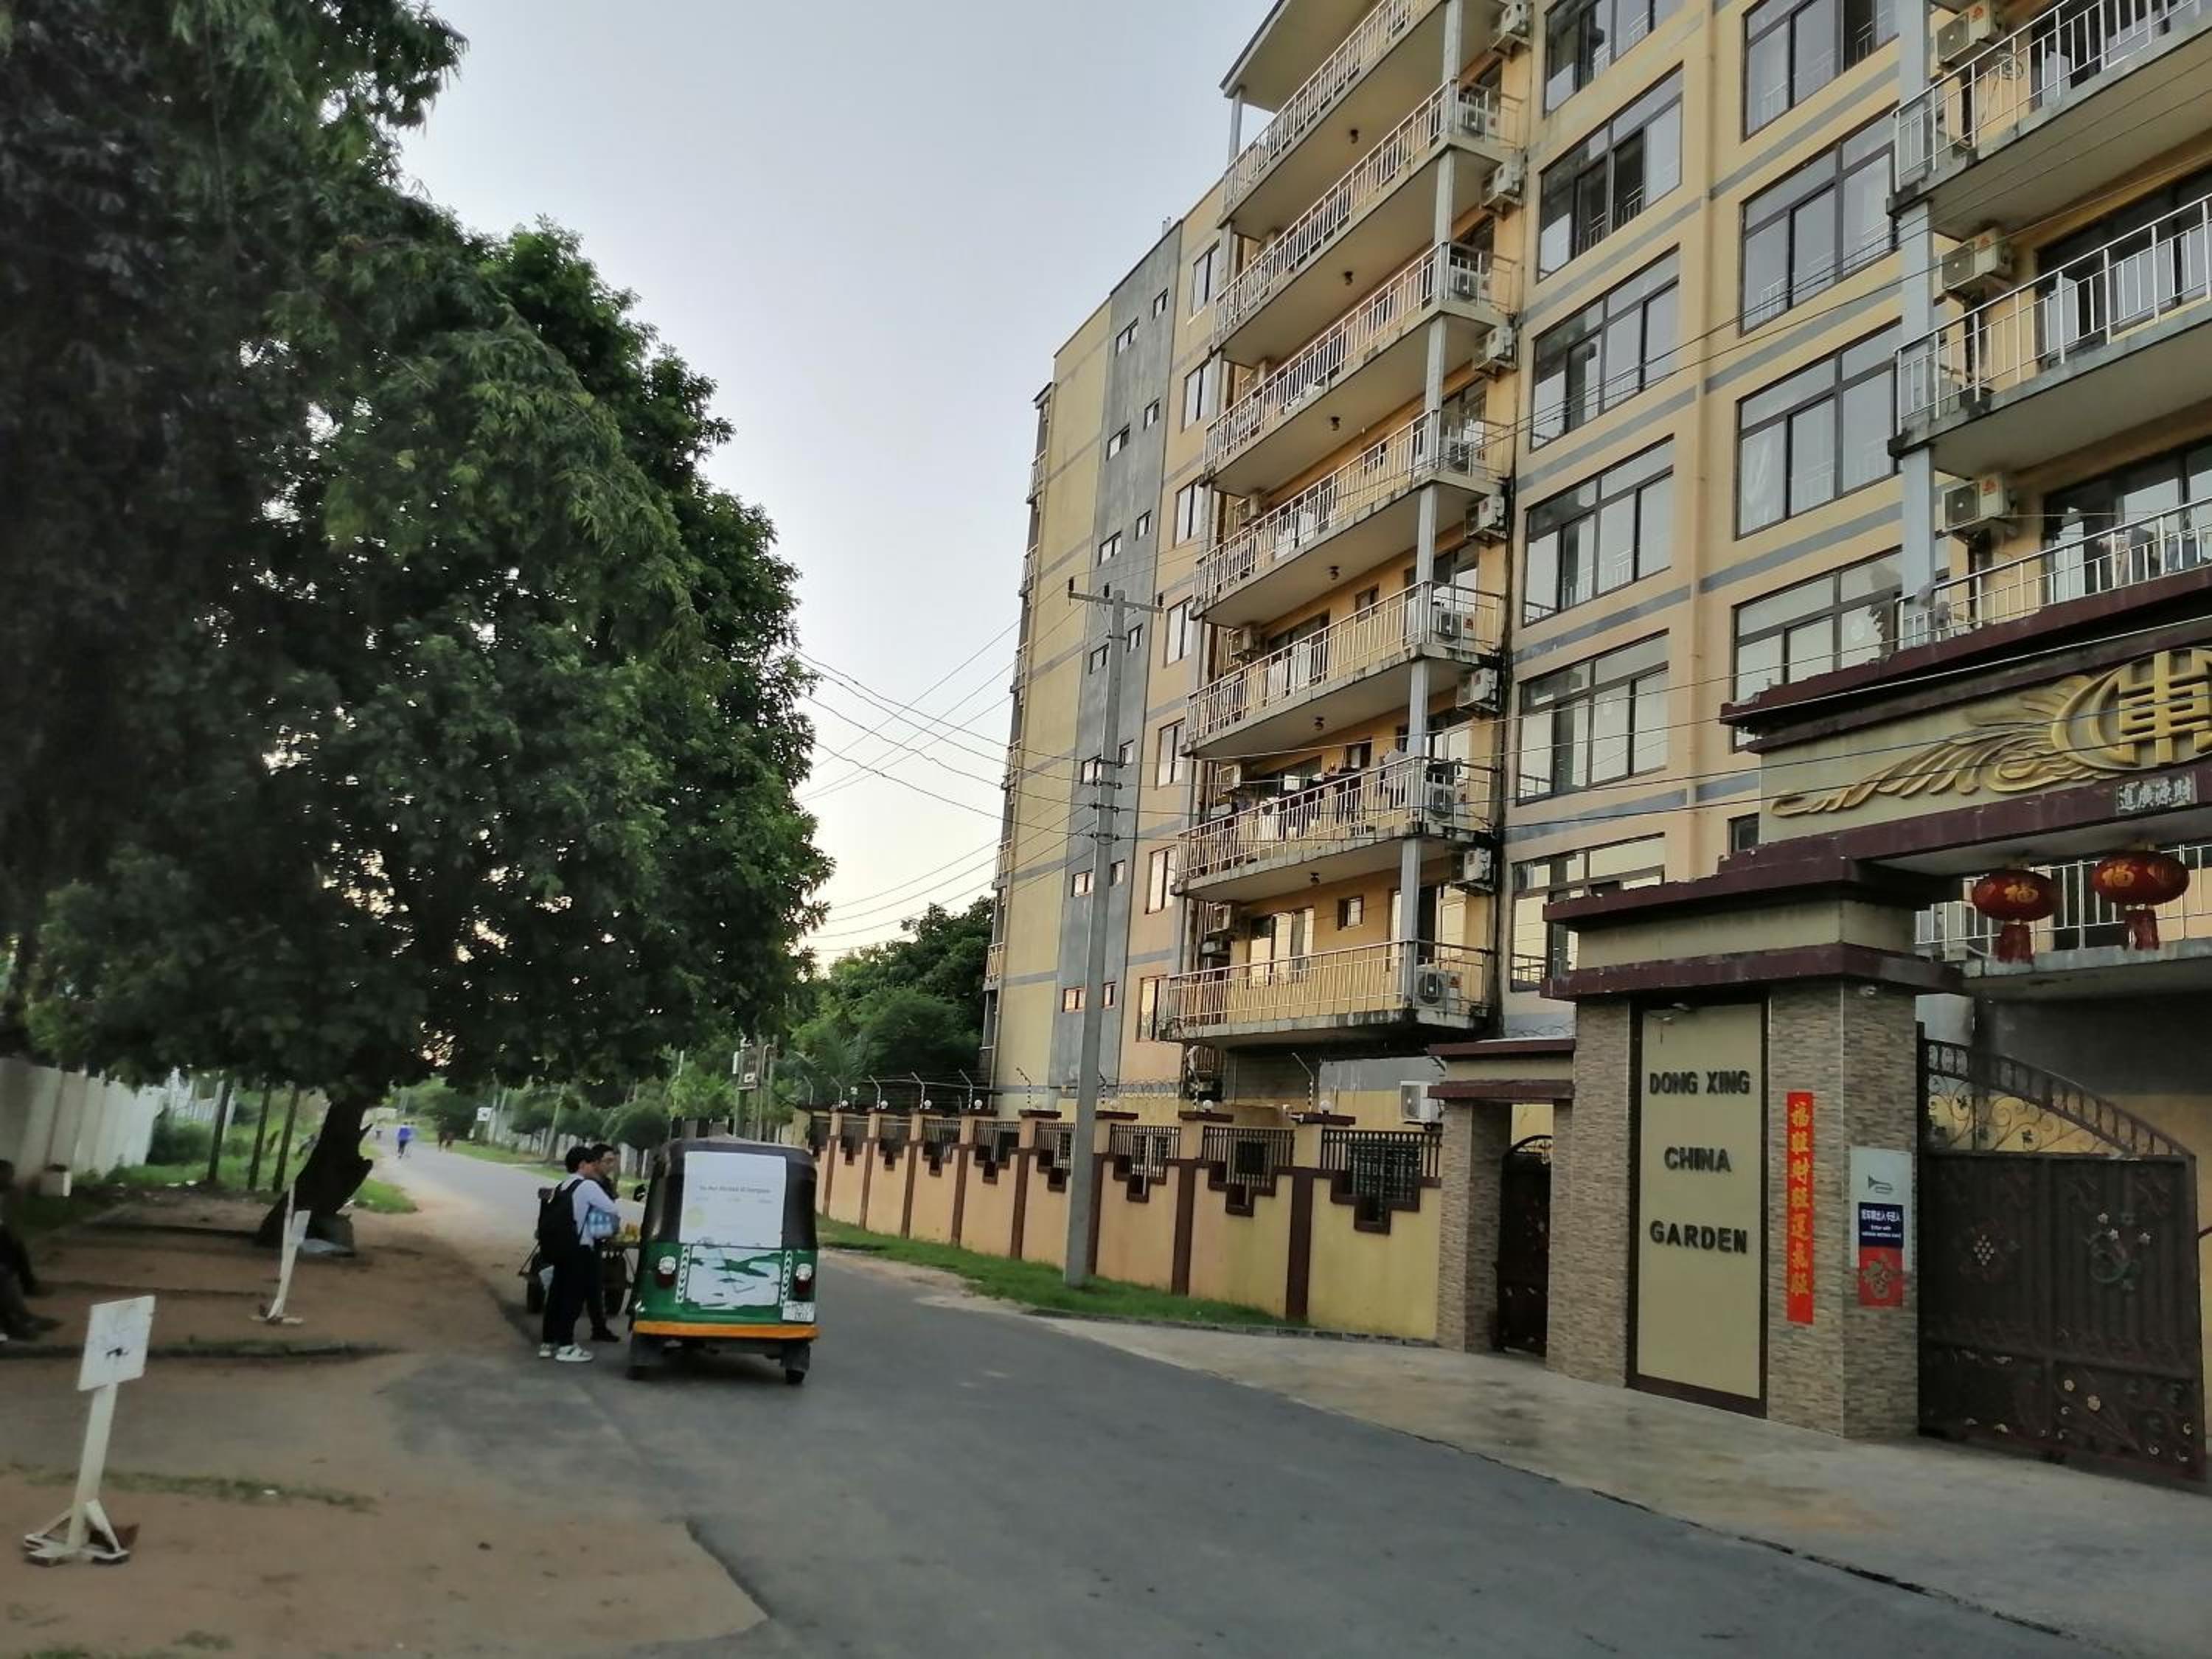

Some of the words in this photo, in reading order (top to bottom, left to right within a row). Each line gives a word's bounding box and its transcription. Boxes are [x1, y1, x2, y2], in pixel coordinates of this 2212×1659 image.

[1649, 1071, 1699, 1095] DONG
[1706, 1071, 1750, 1095] XING
[1664, 1147, 1732, 1173] CHINA
[1649, 1220, 1747, 1253] GARDEN
